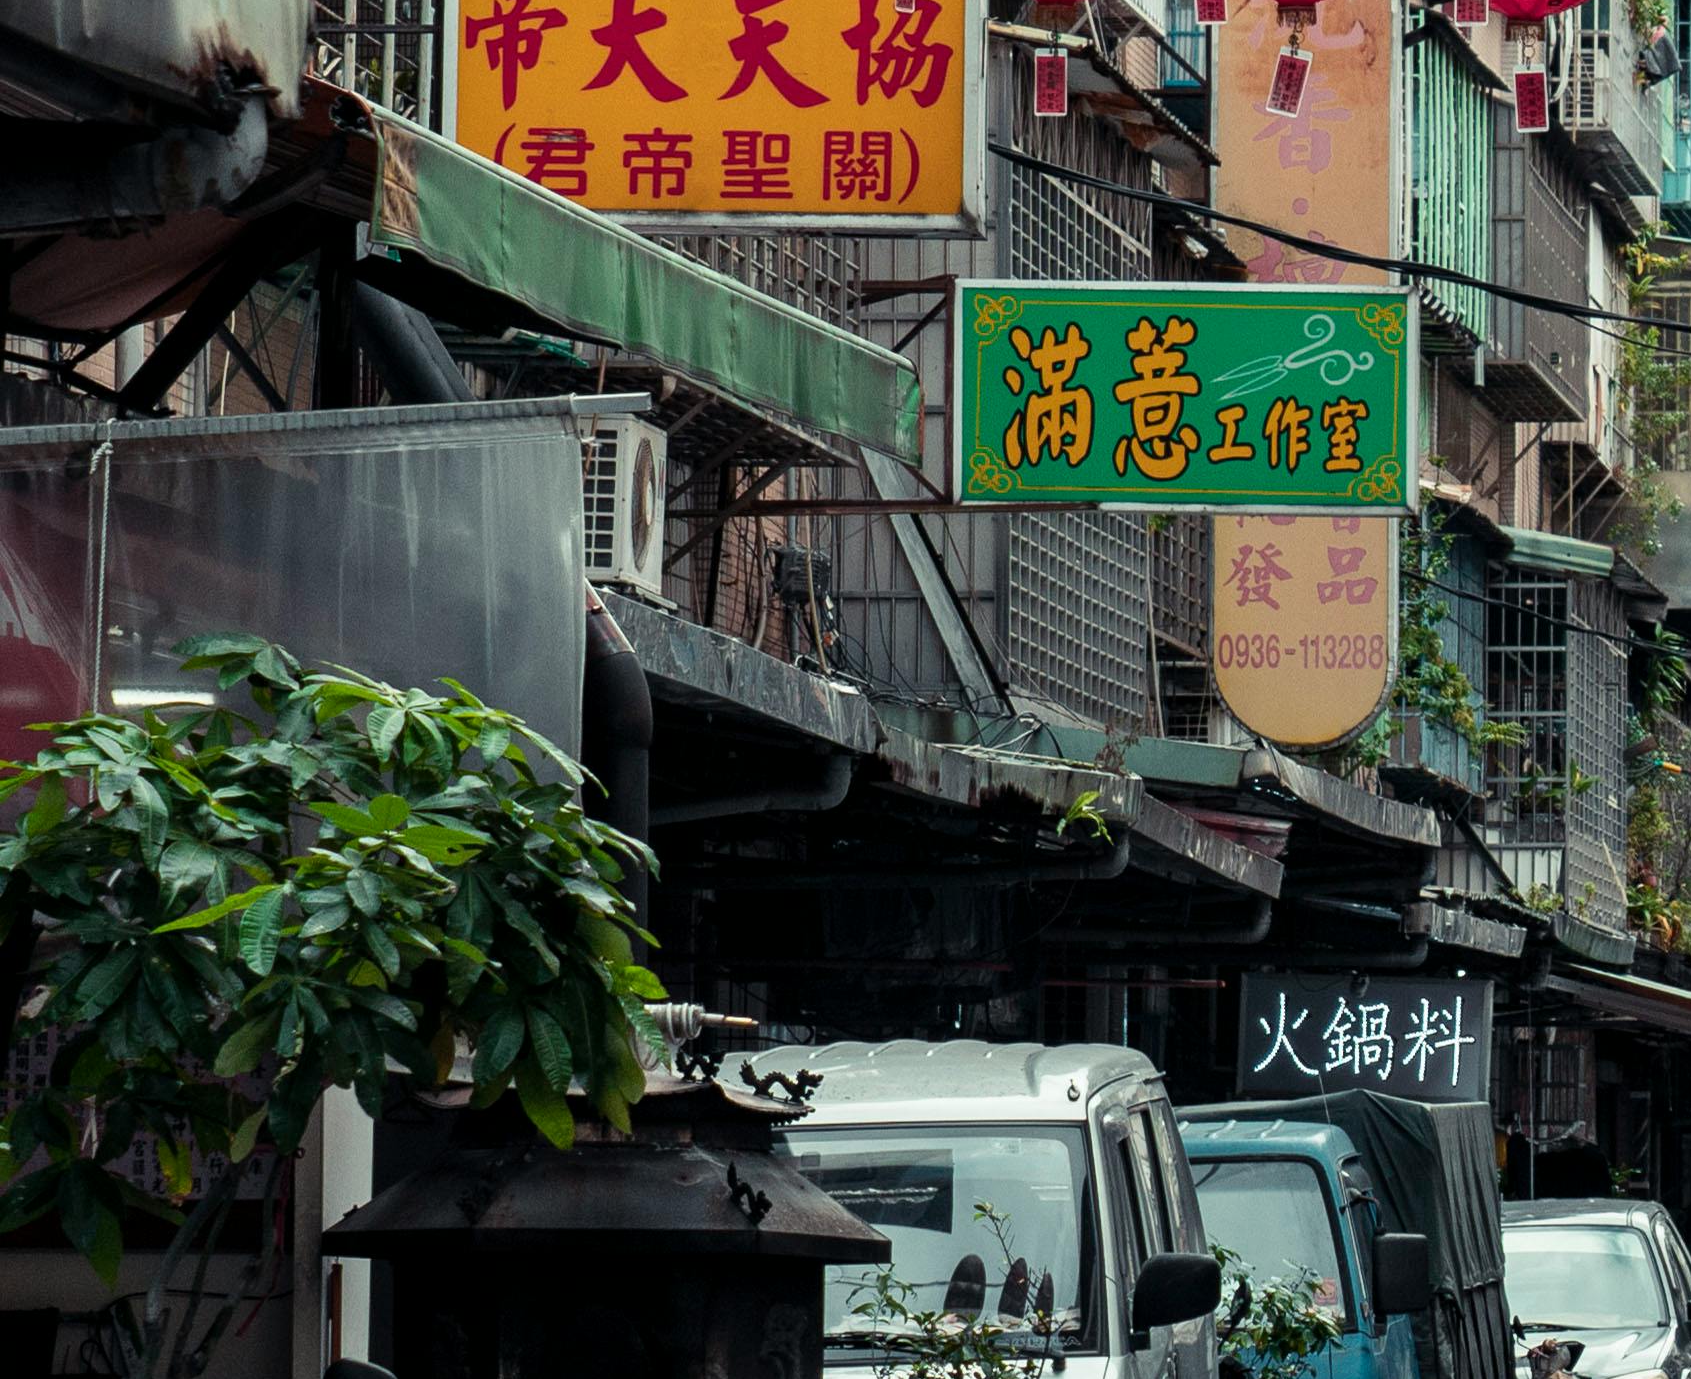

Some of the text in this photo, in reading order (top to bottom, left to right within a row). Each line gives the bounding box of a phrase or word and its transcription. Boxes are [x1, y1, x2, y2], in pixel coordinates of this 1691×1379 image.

[1223, 516, 1294, 611] 發
[1316, 516, 1379, 606] 品
[1218, 633, 1384, 670] 0936-113288
[1254, 992, 1476, 1087] 火鍋料
